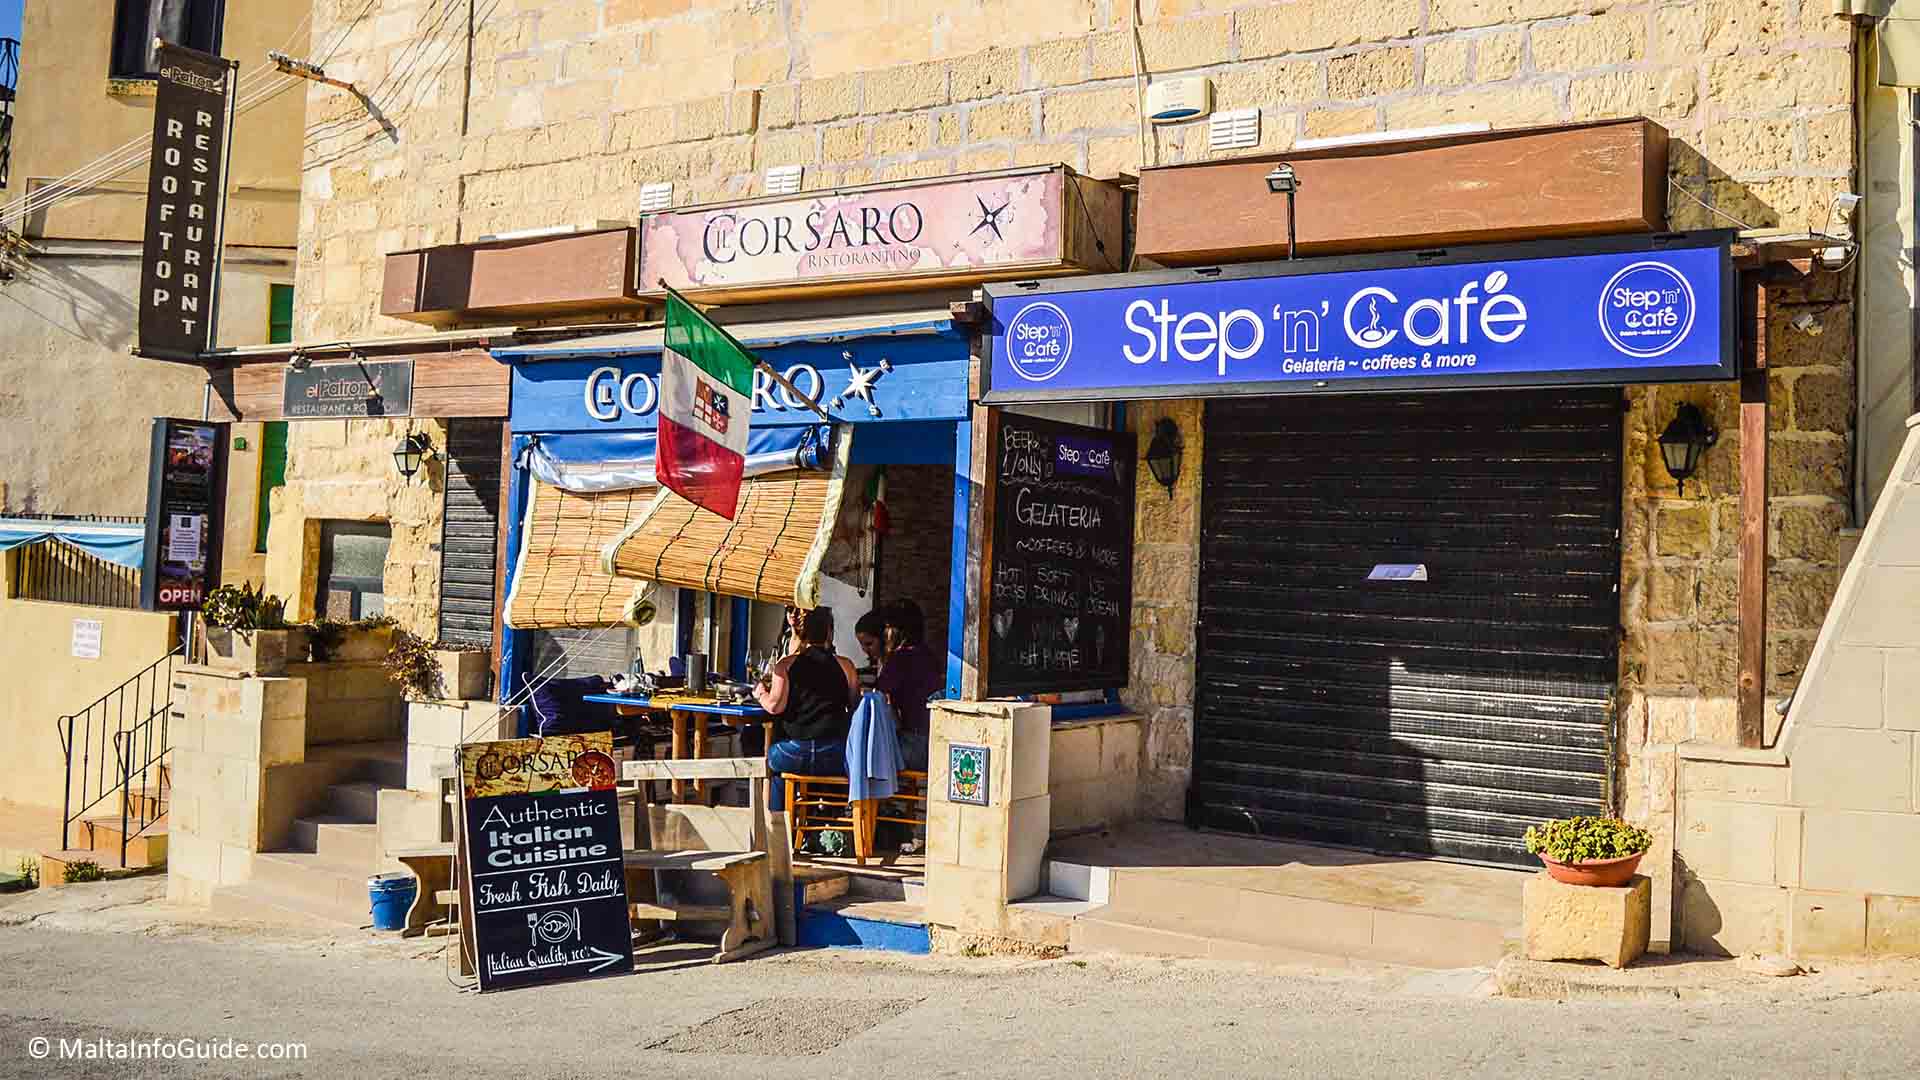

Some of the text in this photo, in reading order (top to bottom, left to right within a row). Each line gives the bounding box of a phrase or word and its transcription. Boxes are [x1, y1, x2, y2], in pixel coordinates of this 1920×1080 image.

[153, 118, 183, 307] ROOFTOP
[181, 110, 213, 335] RESTAURANT
[702, 202, 923, 265] CORSARO
[1613, 287, 1660, 311] Step
[1016, 322, 1049, 343] Step
[1123, 298, 1265, 377] Step
[1343, 270, 1528, 349] Café
[1282, 356, 1346, 374] Gelateria
[1361, 353, 1417, 371] coffees
[1420, 352, 1433, 368] &
[1436, 352, 1477, 368] more
[584, 362, 822, 420] CORO
[1015, 487, 1102, 529] GELATERIA
[160, 588, 201, 603] OPEN
[480, 799, 608, 831] Authentic
[489, 825, 593, 848] Italian
[487, 843, 608, 867] Cuisine
[479, 869, 620, 905] Fresh Fish Daily
[527, 945, 568, 969] Quality
